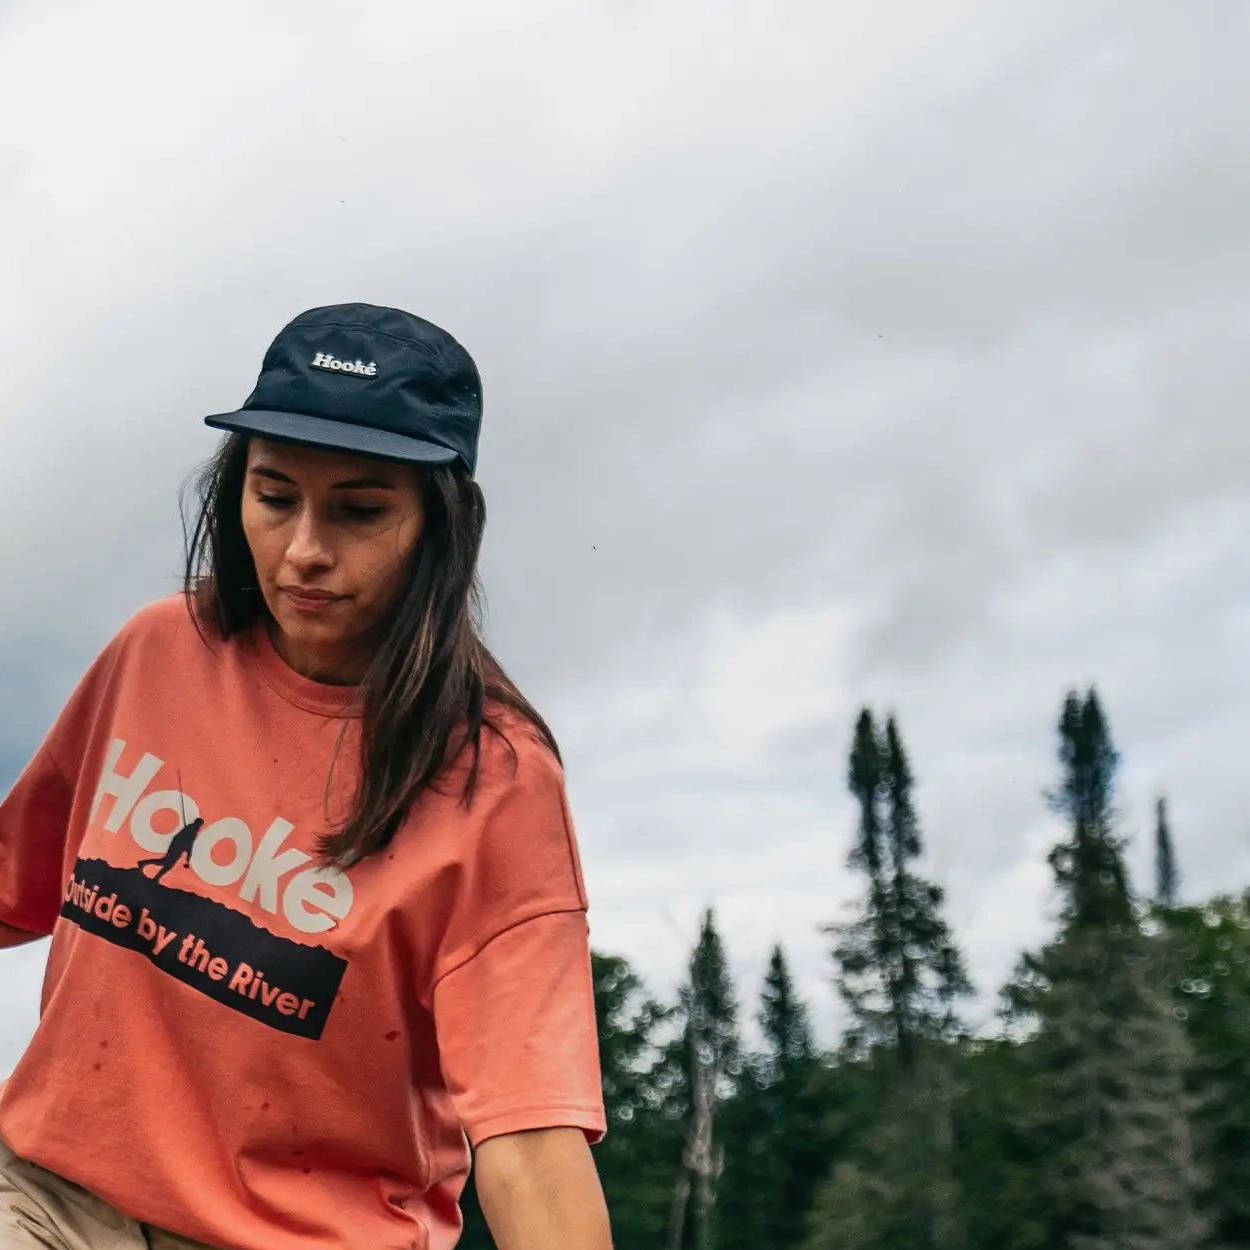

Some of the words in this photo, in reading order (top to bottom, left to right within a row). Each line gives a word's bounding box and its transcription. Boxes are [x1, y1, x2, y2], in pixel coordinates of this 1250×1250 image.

[311, 352, 377, 376] Hooké
[64, 873, 133, 928] Outside
[137, 908, 178, 955] by
[177, 933, 228, 982] the
[229, 962, 316, 1020] River
